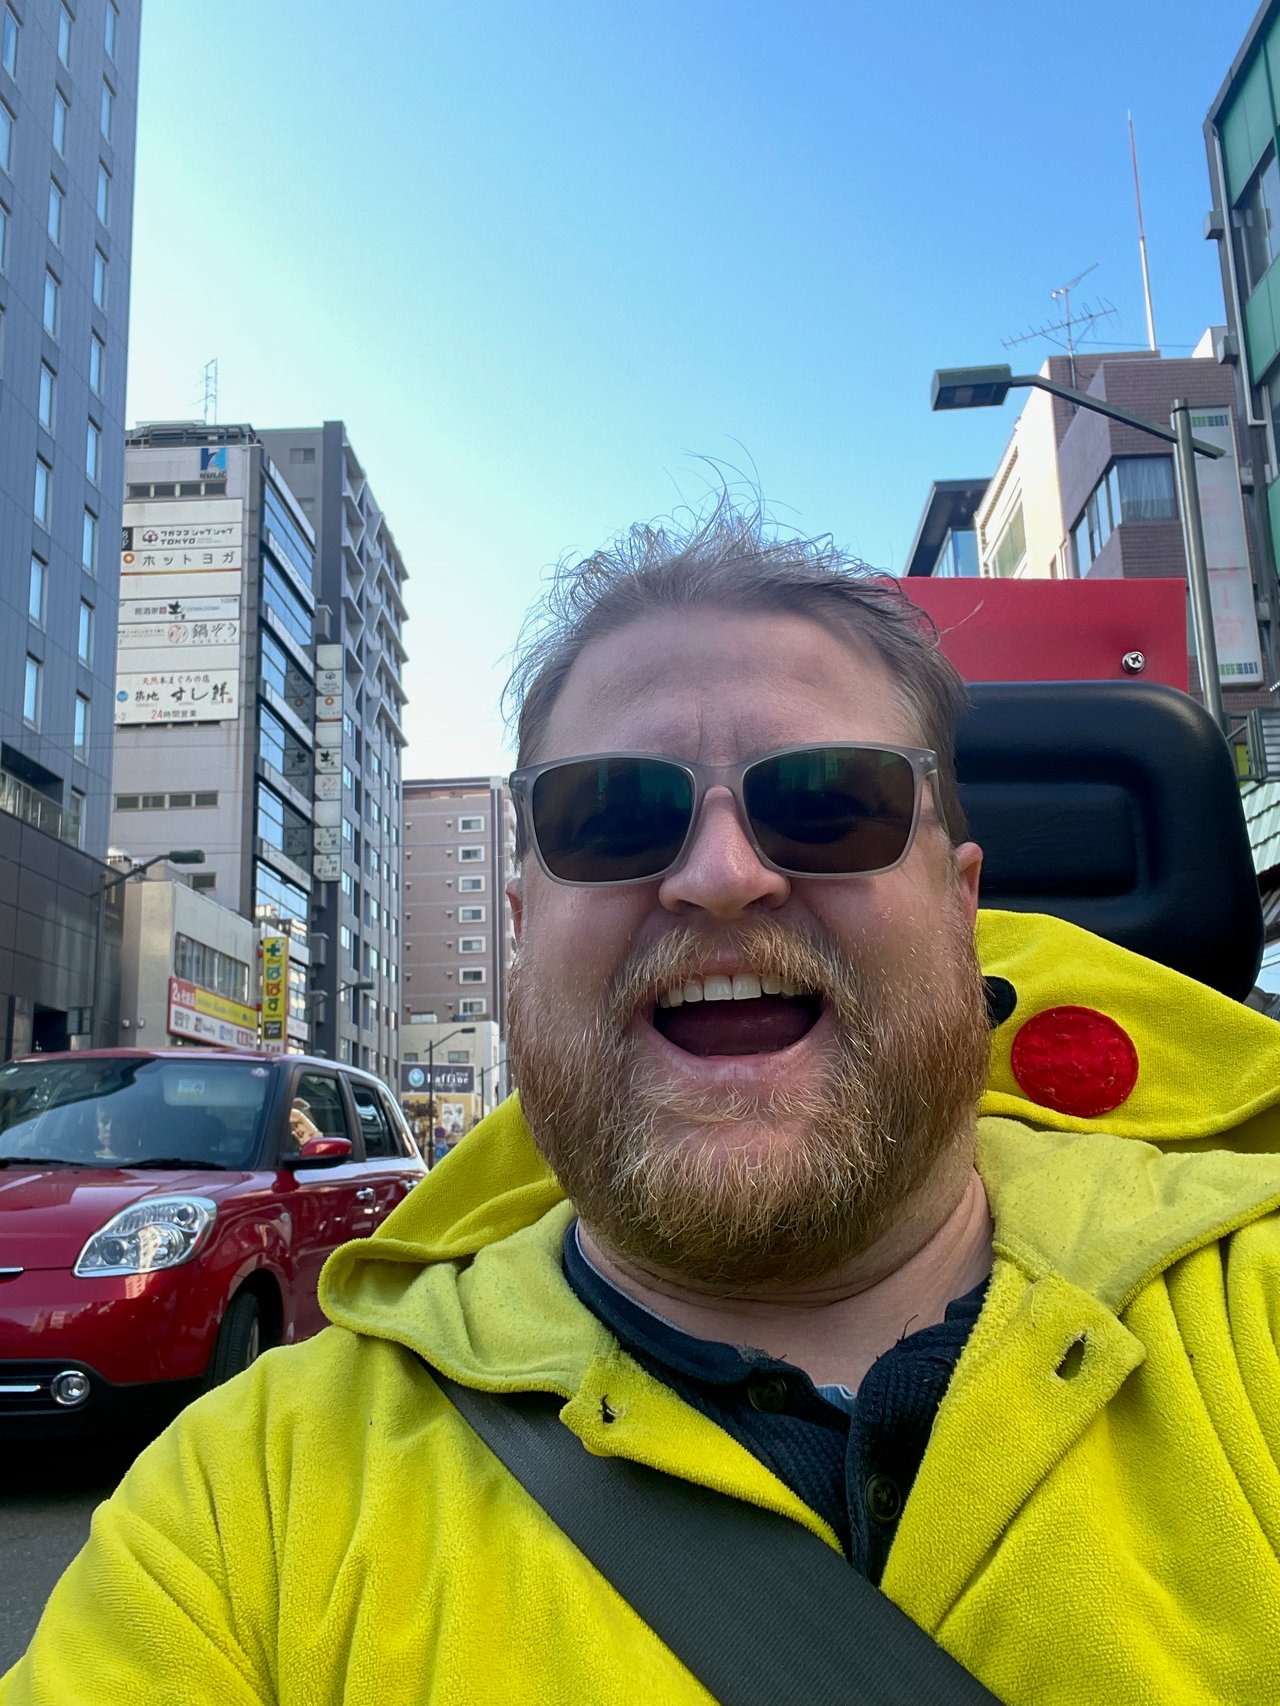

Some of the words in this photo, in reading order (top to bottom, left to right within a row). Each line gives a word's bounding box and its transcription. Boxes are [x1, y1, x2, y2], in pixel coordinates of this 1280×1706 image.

[142, 551, 236, 566] ホットヨガ
[192, 622, 237, 638] 鍋ぞう
[151, 709, 197, 720] 24時間営業
